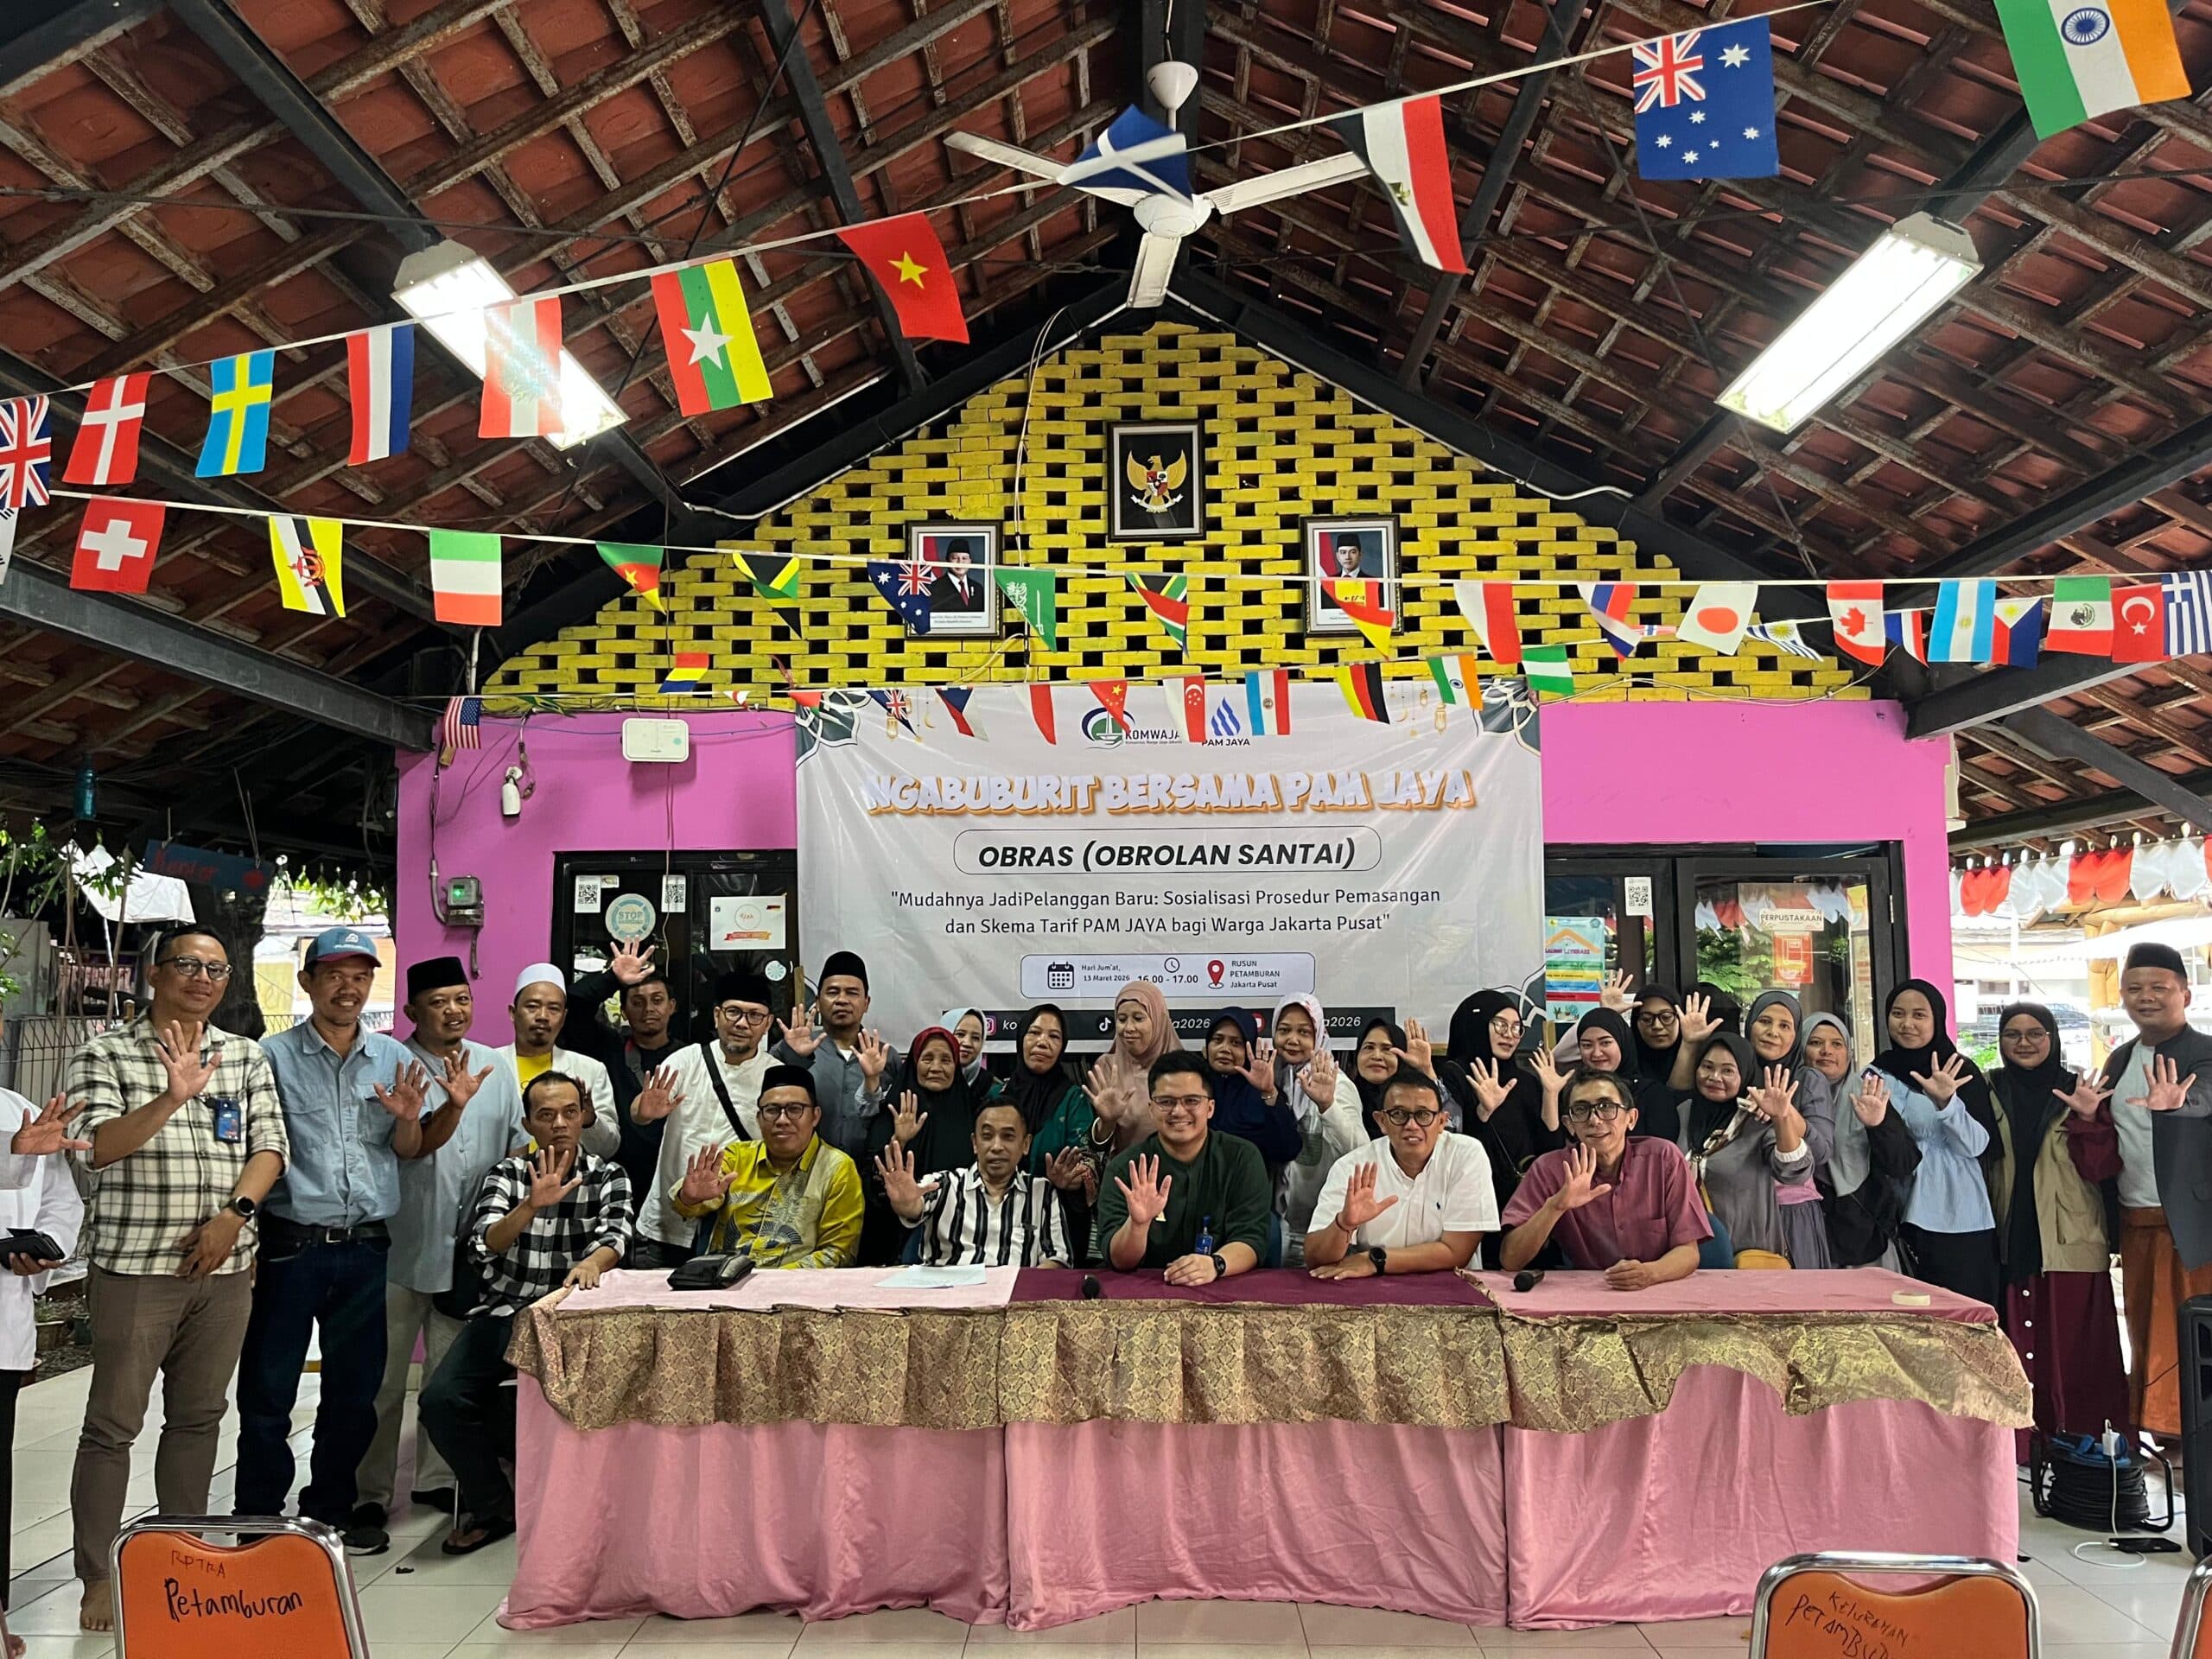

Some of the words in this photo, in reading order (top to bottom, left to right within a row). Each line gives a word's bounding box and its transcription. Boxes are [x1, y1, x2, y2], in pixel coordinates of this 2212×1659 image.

[1225, 738, 1250, 747] JAYA
[862, 774, 1102, 816] NGABUBURIT
[1105, 772, 1285, 815] BERSAMA
[1286, 771, 1375, 813] PAM
[1377, 769, 1478, 811] JAYA
[978, 845, 1074, 868] OBRAS
[1082, 840, 1231, 872] (OBROLAN
[1237, 836, 1356, 870] SANTAI)
[891, 891, 985, 910] "Mudahnya
[988, 891, 1110, 910] JadiPelanggan
[1115, 891, 1159, 906] Baru:
[1163, 890, 1250, 906] Sosialisasi
[1255, 889, 1330, 905] Prosedur
[1335, 888, 1440, 906] Pemasangan
[619, 911, 644, 919] STOP
[944, 918, 975, 933] dan
[980, 918, 1035, 933] Skema
[1039, 918, 1078, 933] Tarif
[1083, 918, 1120, 933] PAM
[1124, 917, 1166, 933] JAYA
[1172, 917, 1206, 936] bagi
[1211, 917, 1264, 935] Warga
[1269, 916, 1332, 931] Jakarta
[1337, 913, 1390, 930] Pusat"
[1760, 913, 1822, 922] PERPUSTAKAAN
[1173, 975, 1198, 983] 17.00
[163, 1576, 304, 1623] Petamburan
